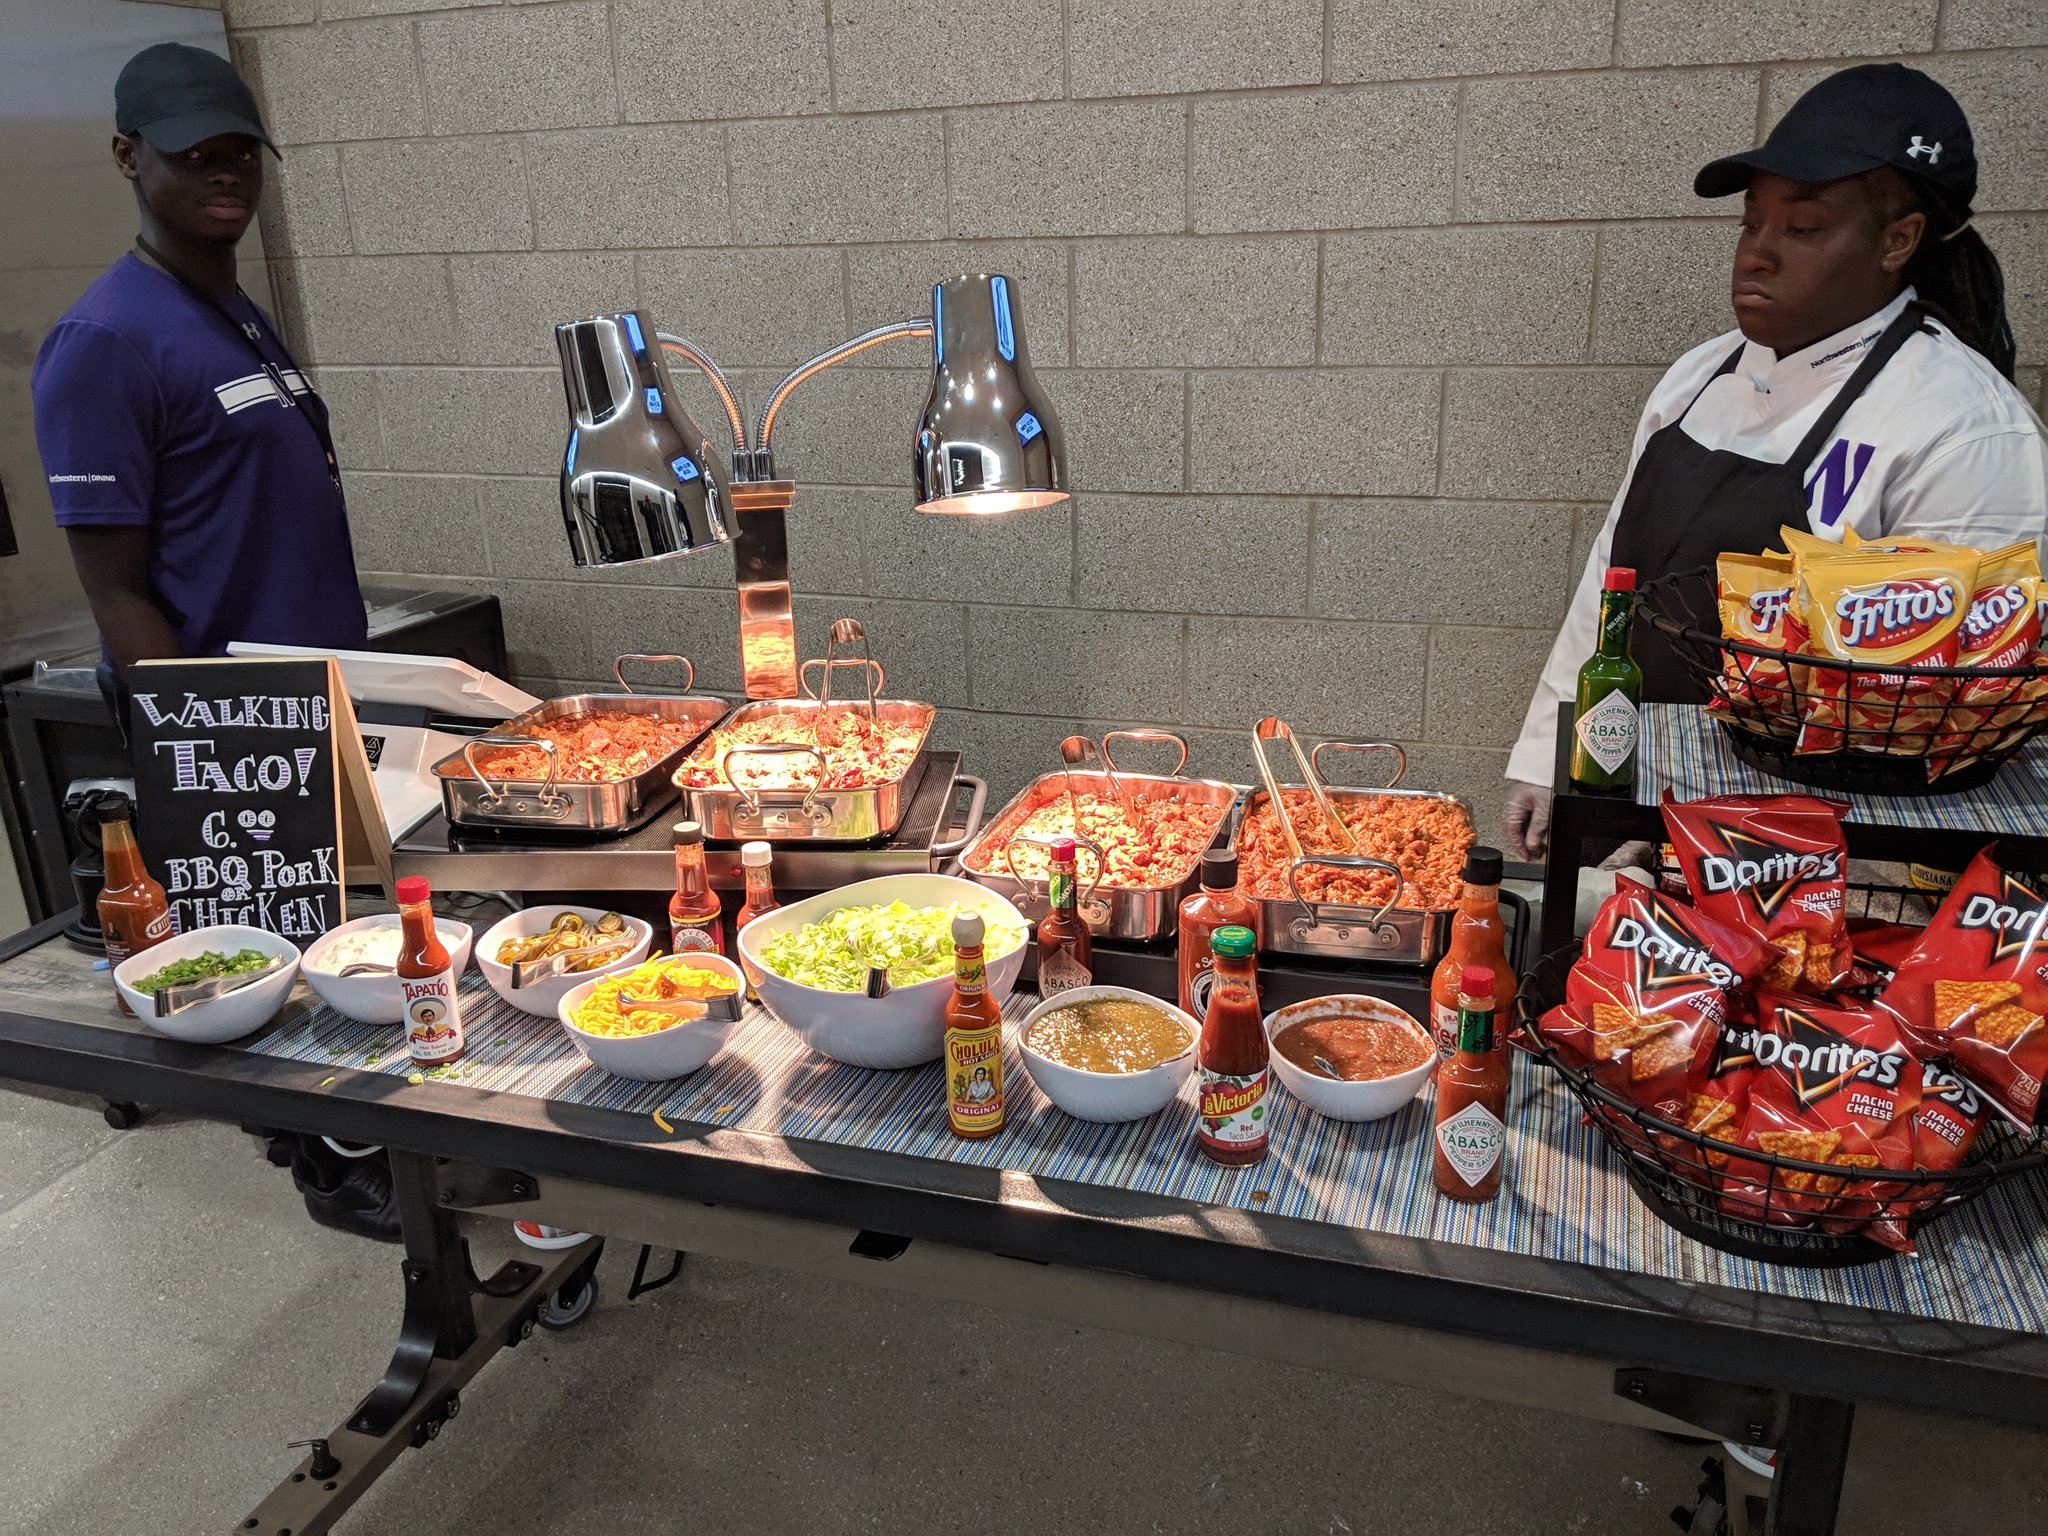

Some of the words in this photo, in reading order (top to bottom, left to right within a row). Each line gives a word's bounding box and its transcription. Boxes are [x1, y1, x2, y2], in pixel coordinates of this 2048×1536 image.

[91, 474, 116, 482] DINING
[1802, 438, 1876, 527] N
[1606, 611, 1626, 631] MILDER
[1835, 584, 1955, 647] Fritos
[1880, 628, 1916, 642] BRAND
[133, 693, 329, 731] WALKING
[1583, 721, 1639, 737] TABASCO
[1600, 747, 1622, 756] PEPPER
[154, 740, 316, 796] TACO!
[165, 856, 252, 892] BBQ
[1703, 852, 1838, 891] Doritos
[1912, 864, 1953, 887] LOUISIANA
[221, 886, 251, 901] OR
[1804, 889, 1841, 902] NACHO
[1803, 898, 1842, 912] CHEESE
[676, 930, 709, 942] DAVE'S
[402, 978, 449, 1003] TAPATÍO
[951, 1035, 999, 1064] CHOLULA
[1754, 1033, 1903, 1084] Doritos
[963, 1057, 981, 1066] HOT
[2017, 1075, 2040, 1095] 240
[956, 1102, 1000, 1115] ORIGINAL
[1203, 1097, 1215, 1115] La
[1211, 1082, 1263, 1113] Victoria
[1851, 1093, 1894, 1111] NACHO
[1846, 1103, 1893, 1121] CHEESE
[1240, 1123, 1254, 1132] Red
[1919, 1116, 1962, 1147] CHEESE
[1926, 1109, 1966, 1137] NACHO
[1229, 1131, 1244, 1140] Taco
[1441, 1128, 1503, 1149] TABASCO
[1449, 1145, 1474, 1169] PEPPER
[1476, 1148, 1497, 1168] SAUCE
[1461, 1148, 1485, 1156] BRAND
